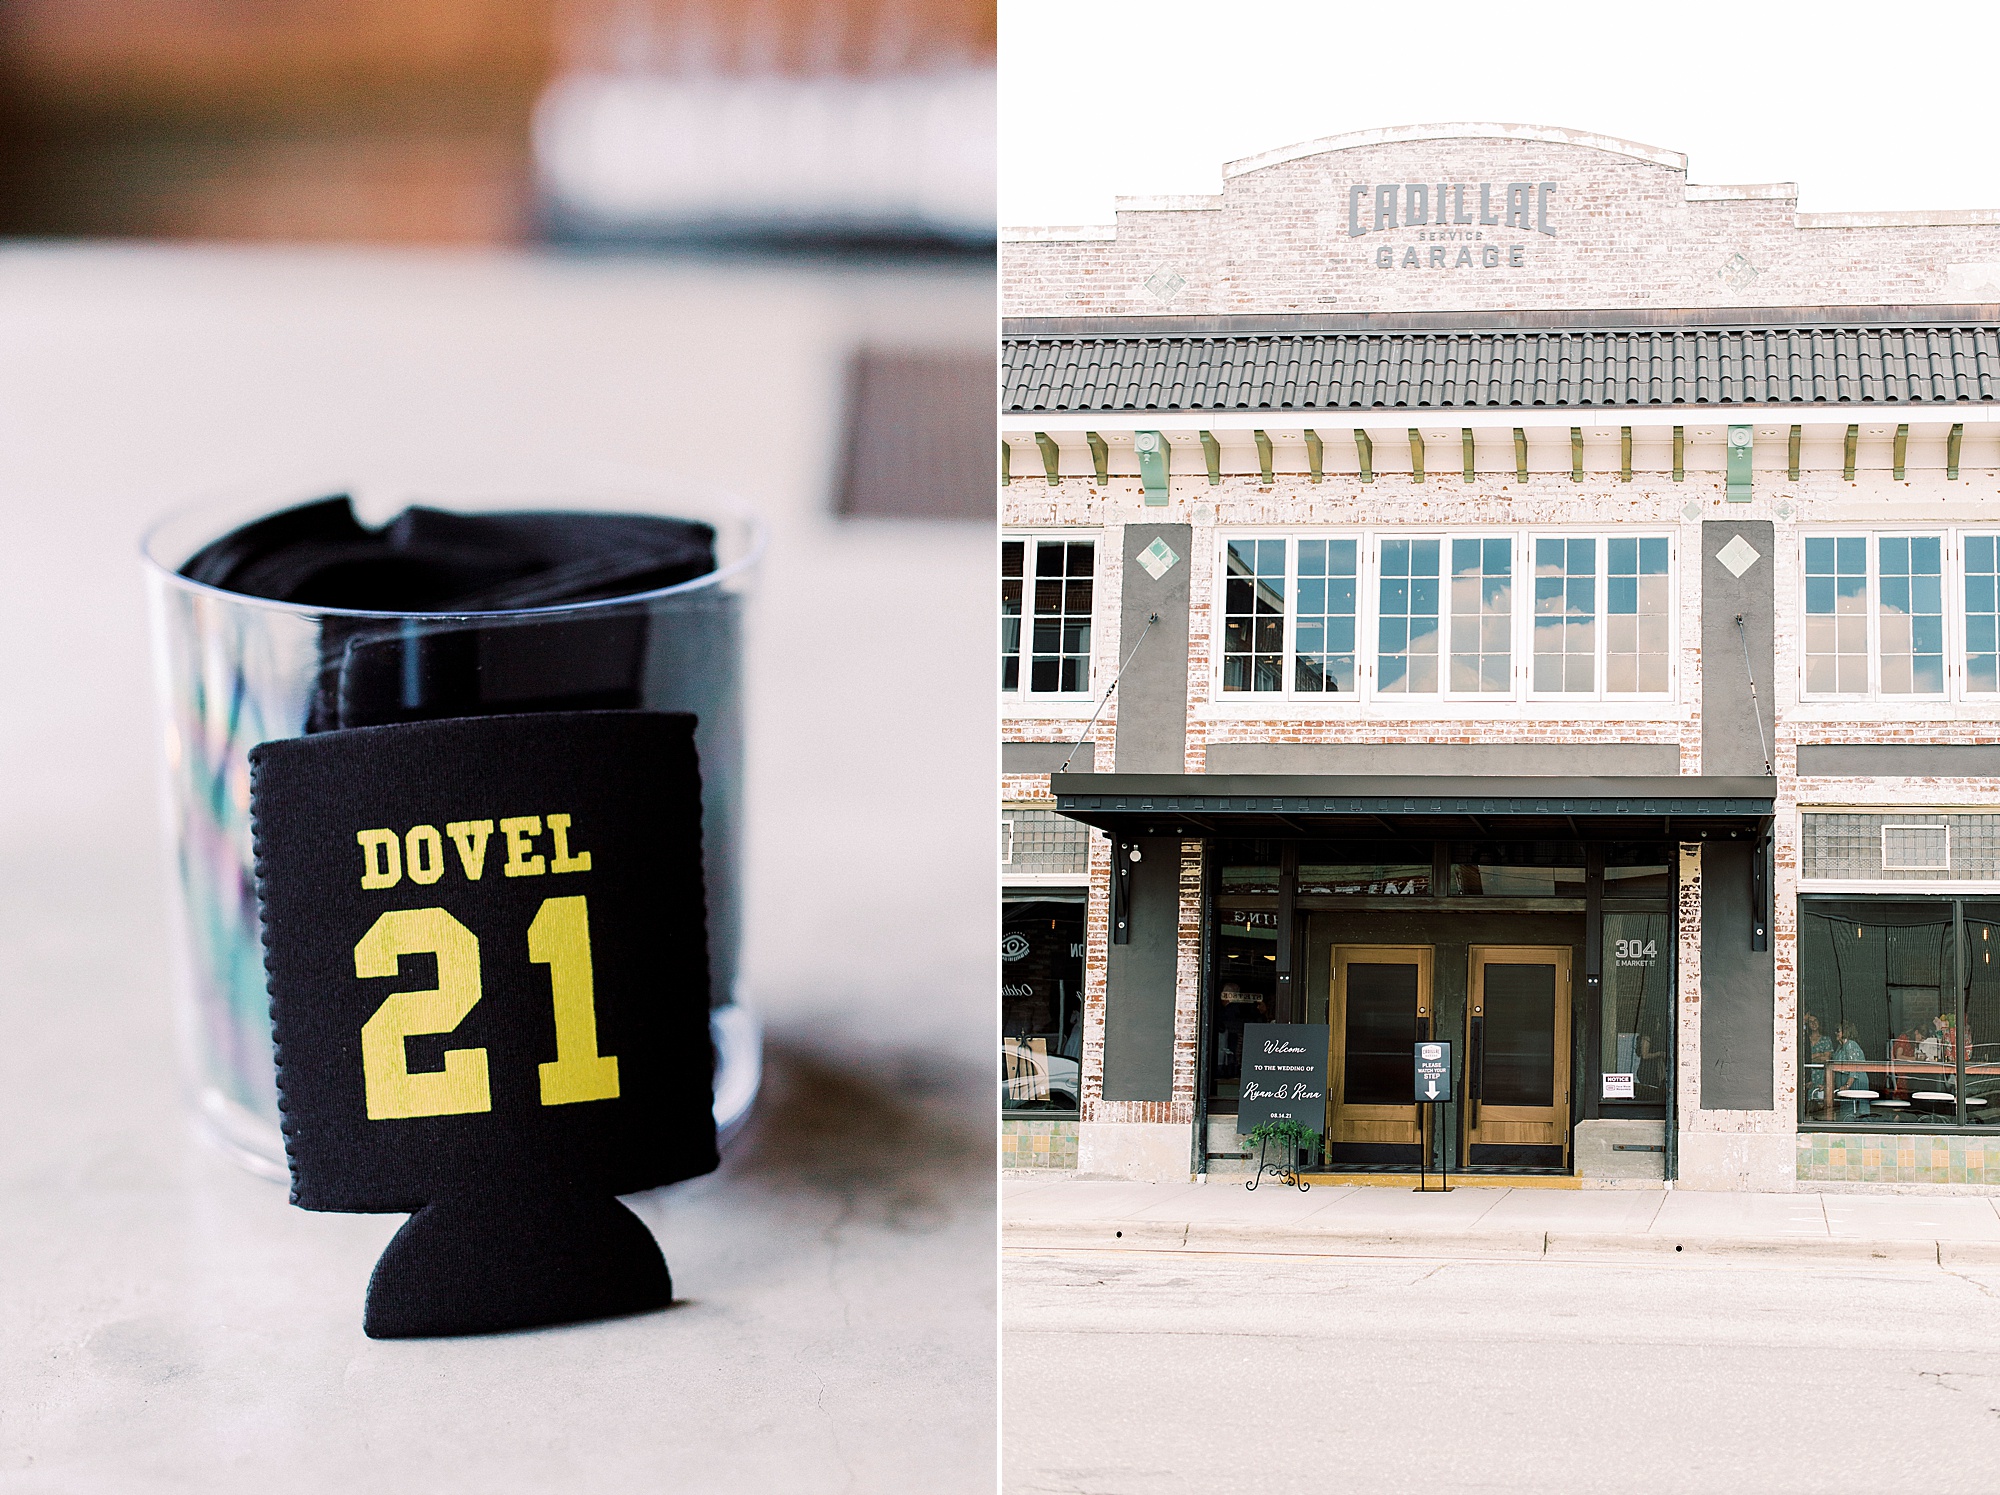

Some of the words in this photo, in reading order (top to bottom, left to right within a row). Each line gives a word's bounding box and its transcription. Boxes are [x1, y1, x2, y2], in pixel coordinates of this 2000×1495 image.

[1348, 182, 1557, 238] CADILLAC
[1419, 232, 1483, 241] SERVICE
[1376, 245, 1525, 269] GARAGE
[356, 813, 592, 890] DOVEL
[1615, 939, 1658, 958] 304
[354, 895, 620, 1120] 21
[1263, 1040, 1307, 1054] Welcome
[1243, 1081, 1275, 1101] Ryan
[1274, 1084, 1288, 1099] &
